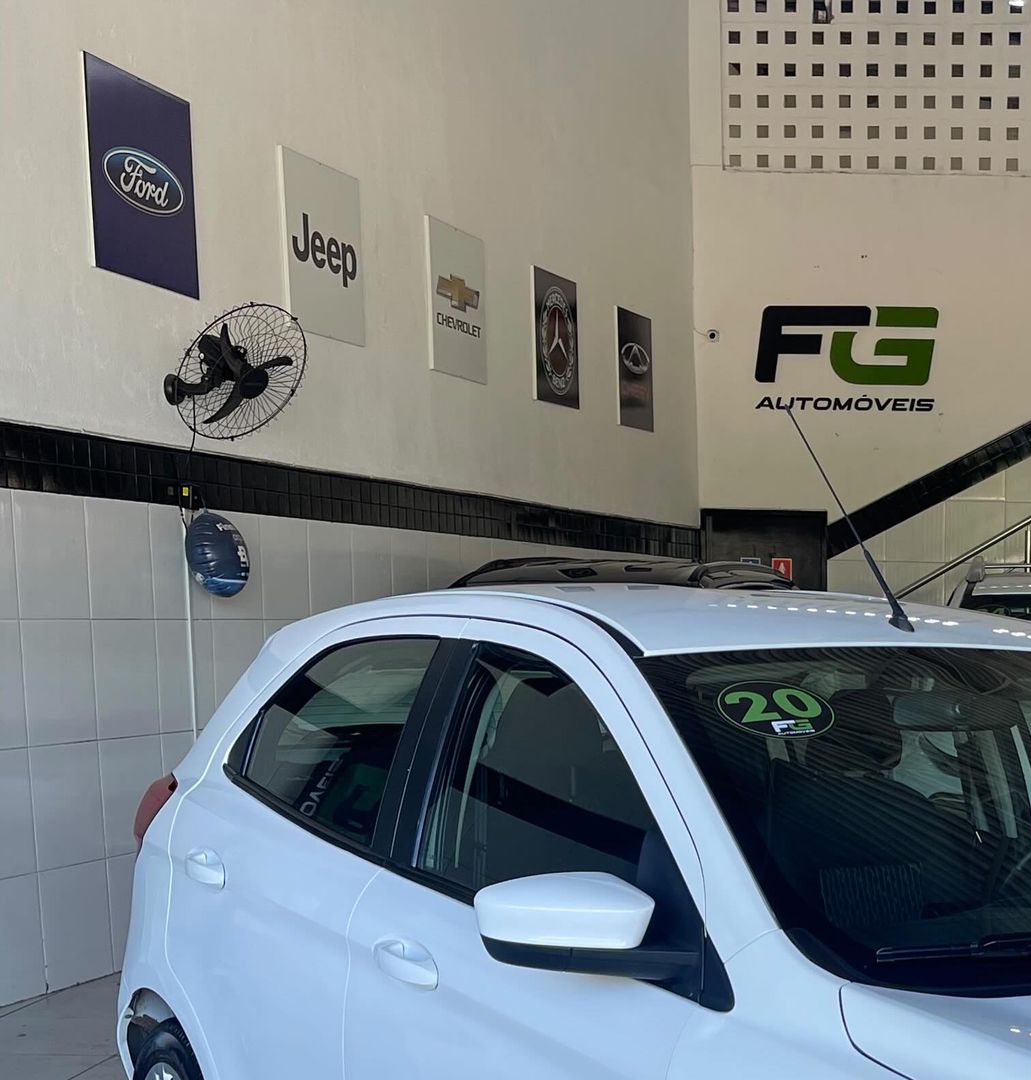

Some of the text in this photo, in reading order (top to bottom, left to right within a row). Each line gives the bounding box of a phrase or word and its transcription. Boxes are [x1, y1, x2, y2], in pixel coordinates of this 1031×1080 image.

[120, 156, 169, 207] Ford
[292, 212, 357, 288] Jeep
[437, 312, 481, 338] CHEVROLET
[755, 305, 939, 386] FG
[755, 395, 935, 412] AUTOMÓVEIS
[724, 689, 822, 723] 20
[771, 719, 813, 733] FG
